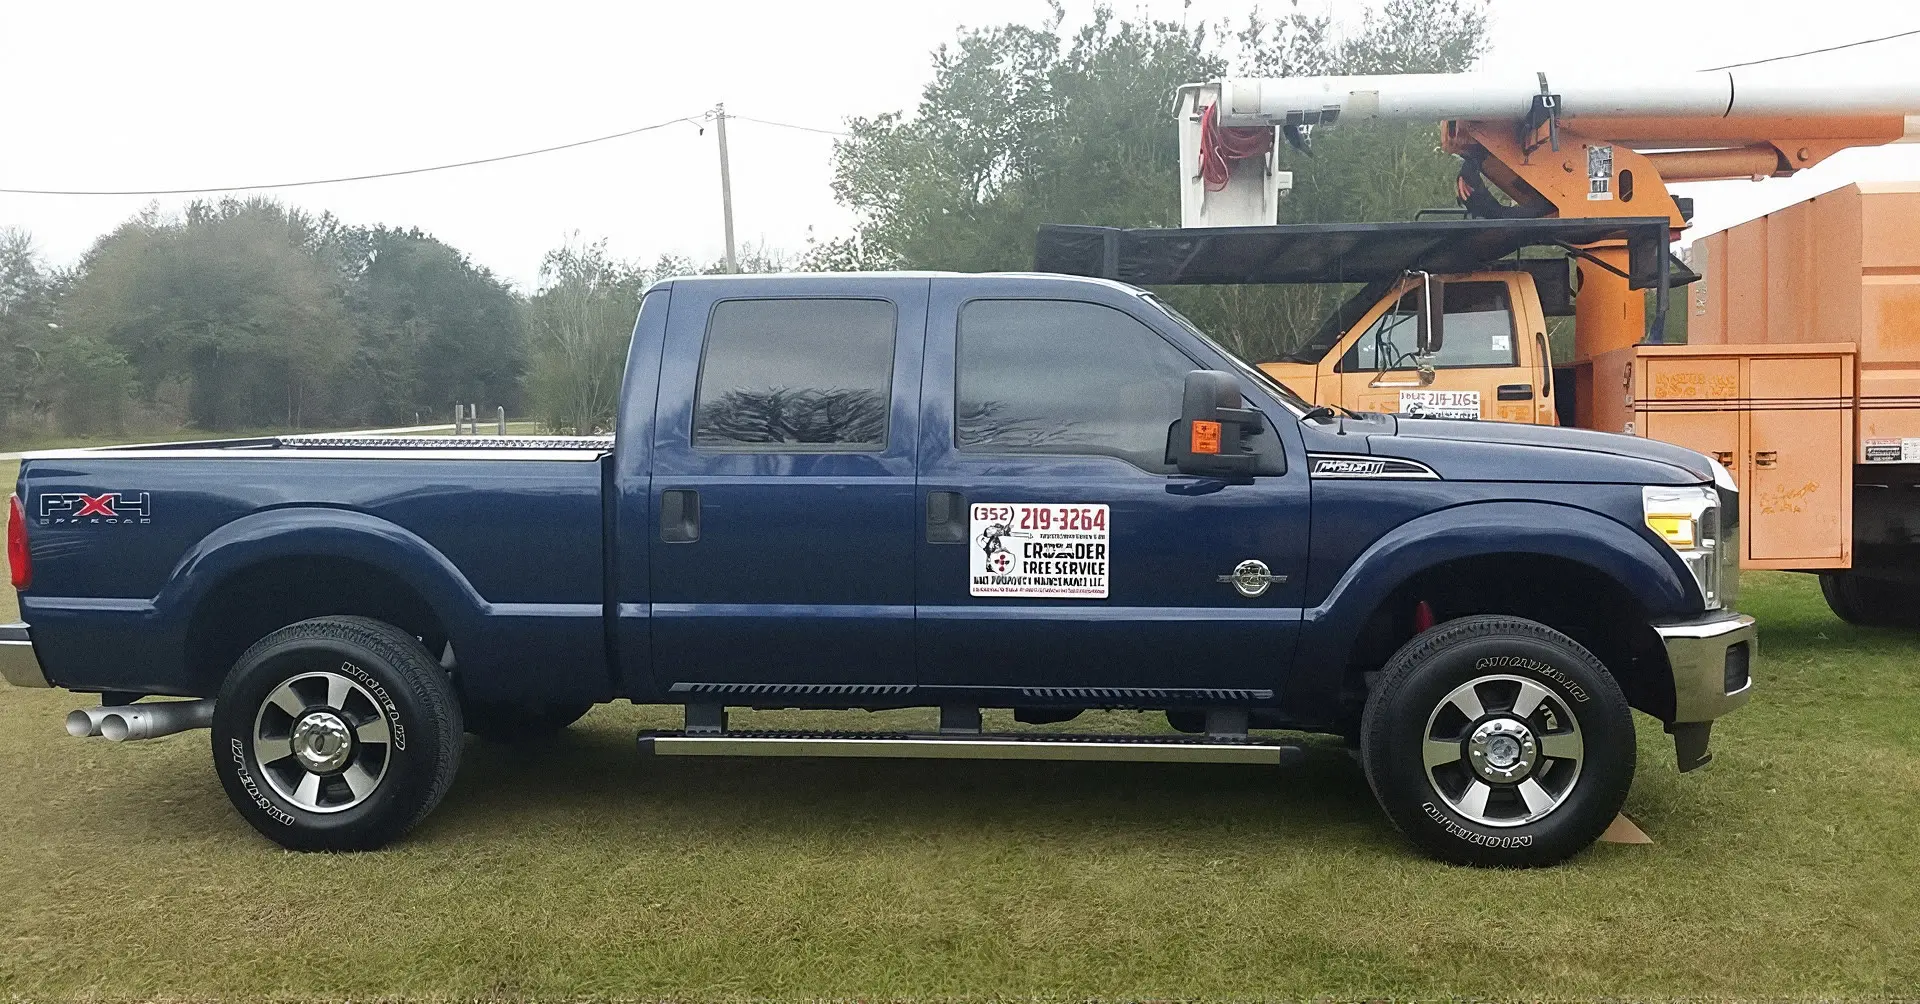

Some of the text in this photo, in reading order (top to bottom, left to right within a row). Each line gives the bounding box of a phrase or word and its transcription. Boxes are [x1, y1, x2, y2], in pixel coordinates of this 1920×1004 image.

[974, 506, 1105, 531] (352) 219-3264
[1023, 561, 1105, 575] TREE SERVICE
